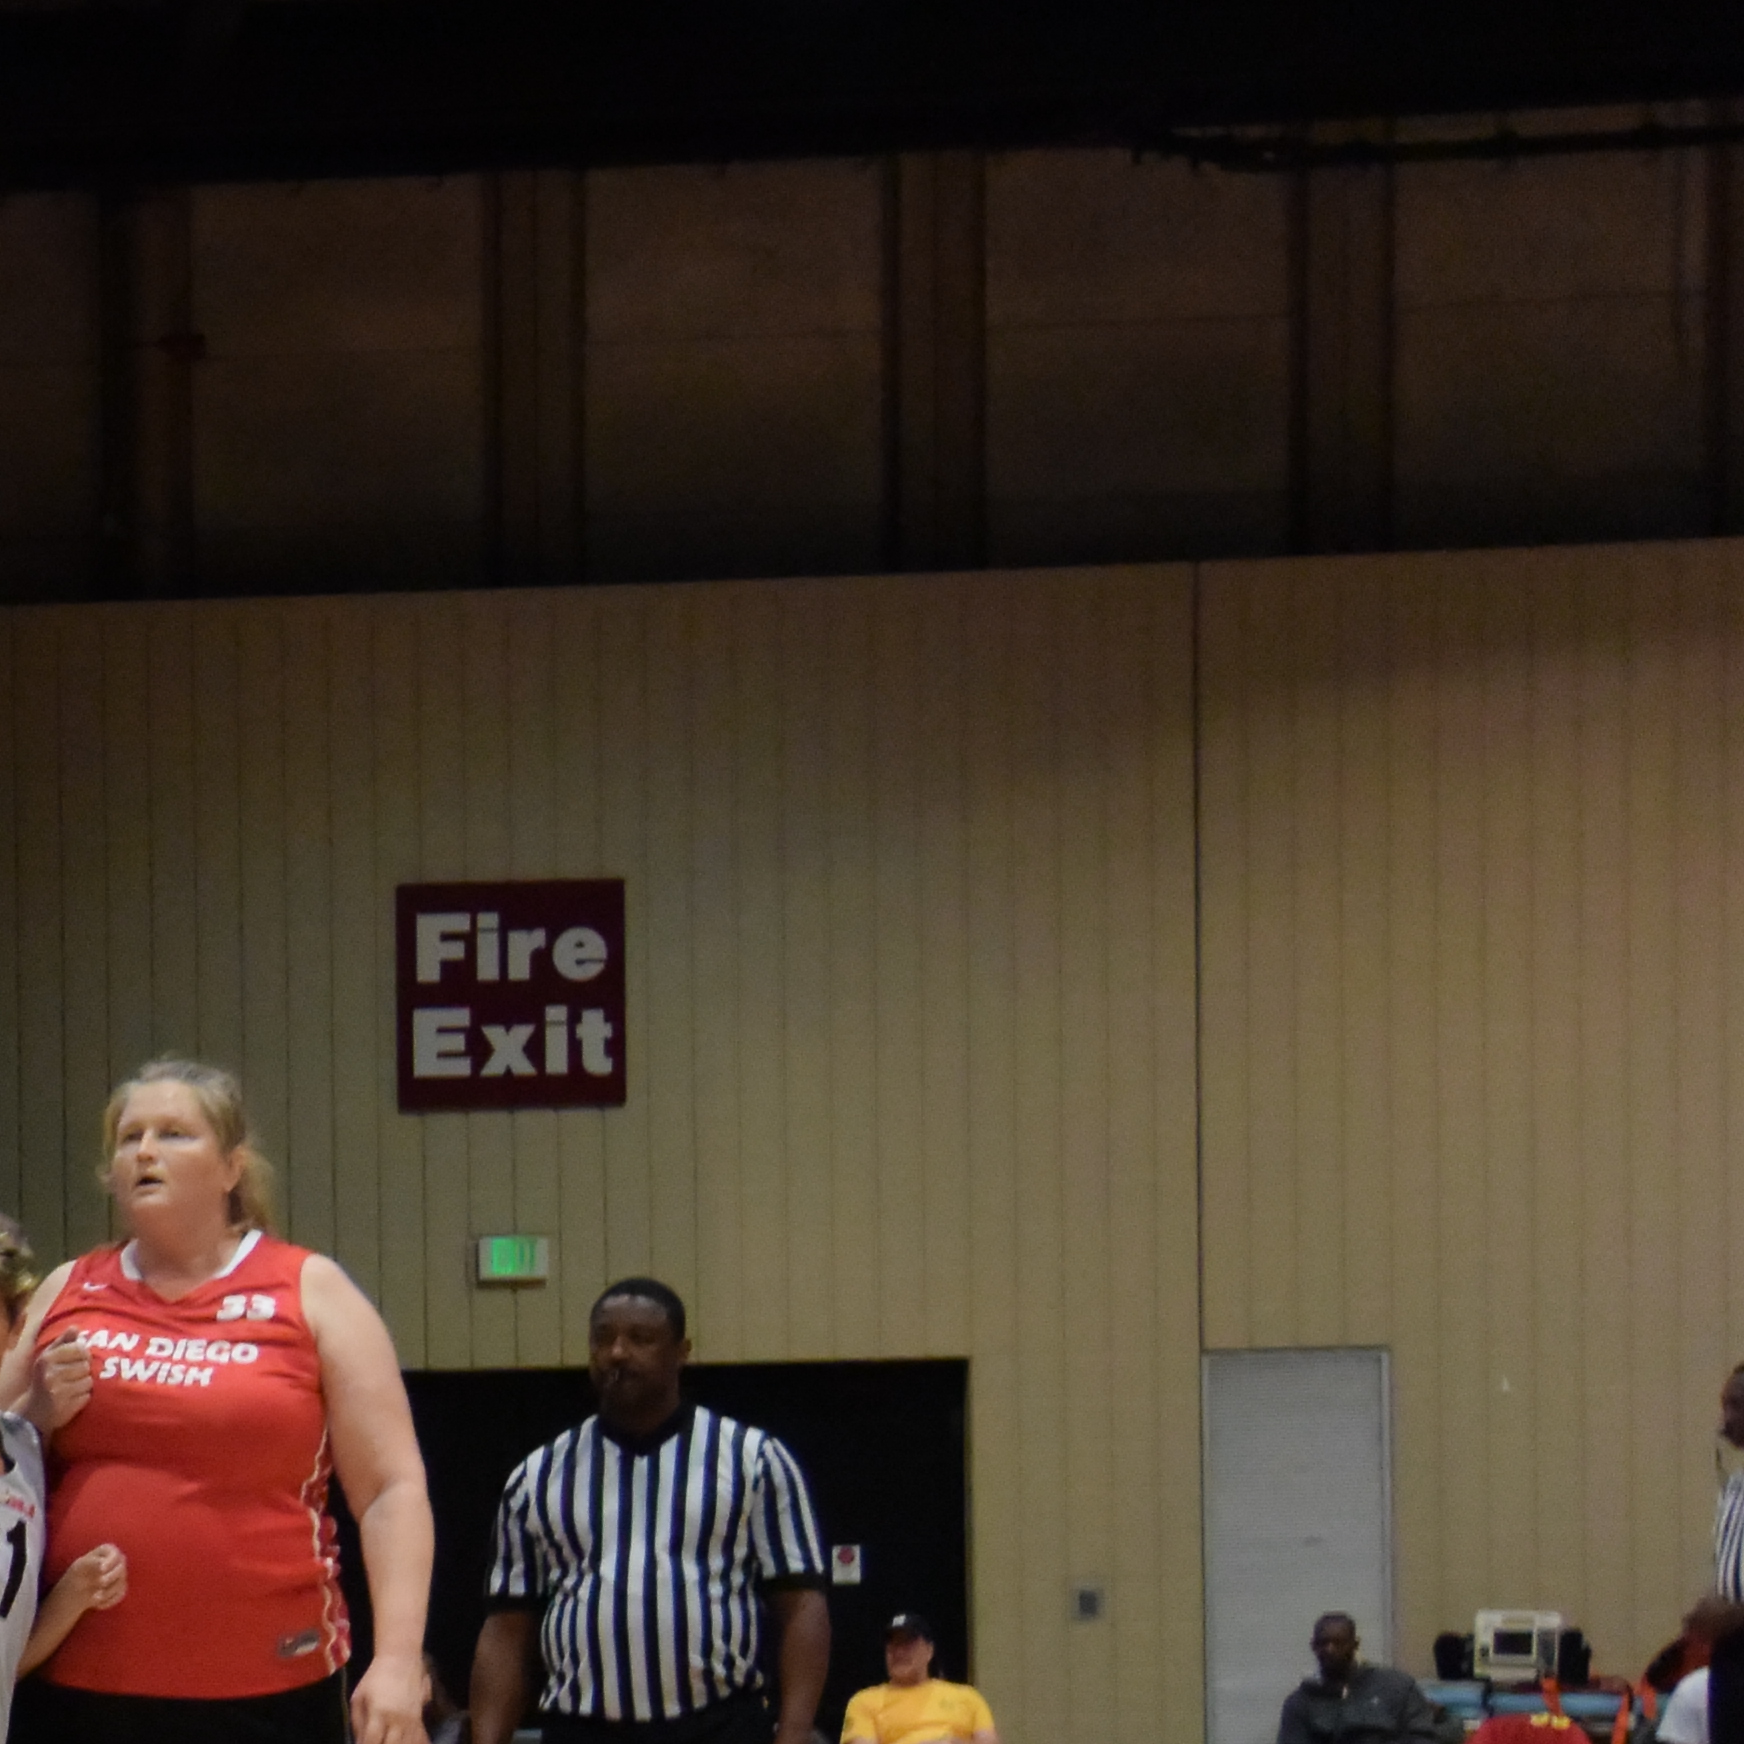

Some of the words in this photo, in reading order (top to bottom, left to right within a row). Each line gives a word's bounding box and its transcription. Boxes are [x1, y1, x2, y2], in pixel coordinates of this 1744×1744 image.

[416, 911, 608, 983] Fire
[413, 1004, 613, 1078] Exit
[216, 1294, 276, 1321] 33
[145, 1336, 259, 1363] DIEGO
[99, 1356, 214, 1387] SWISH
